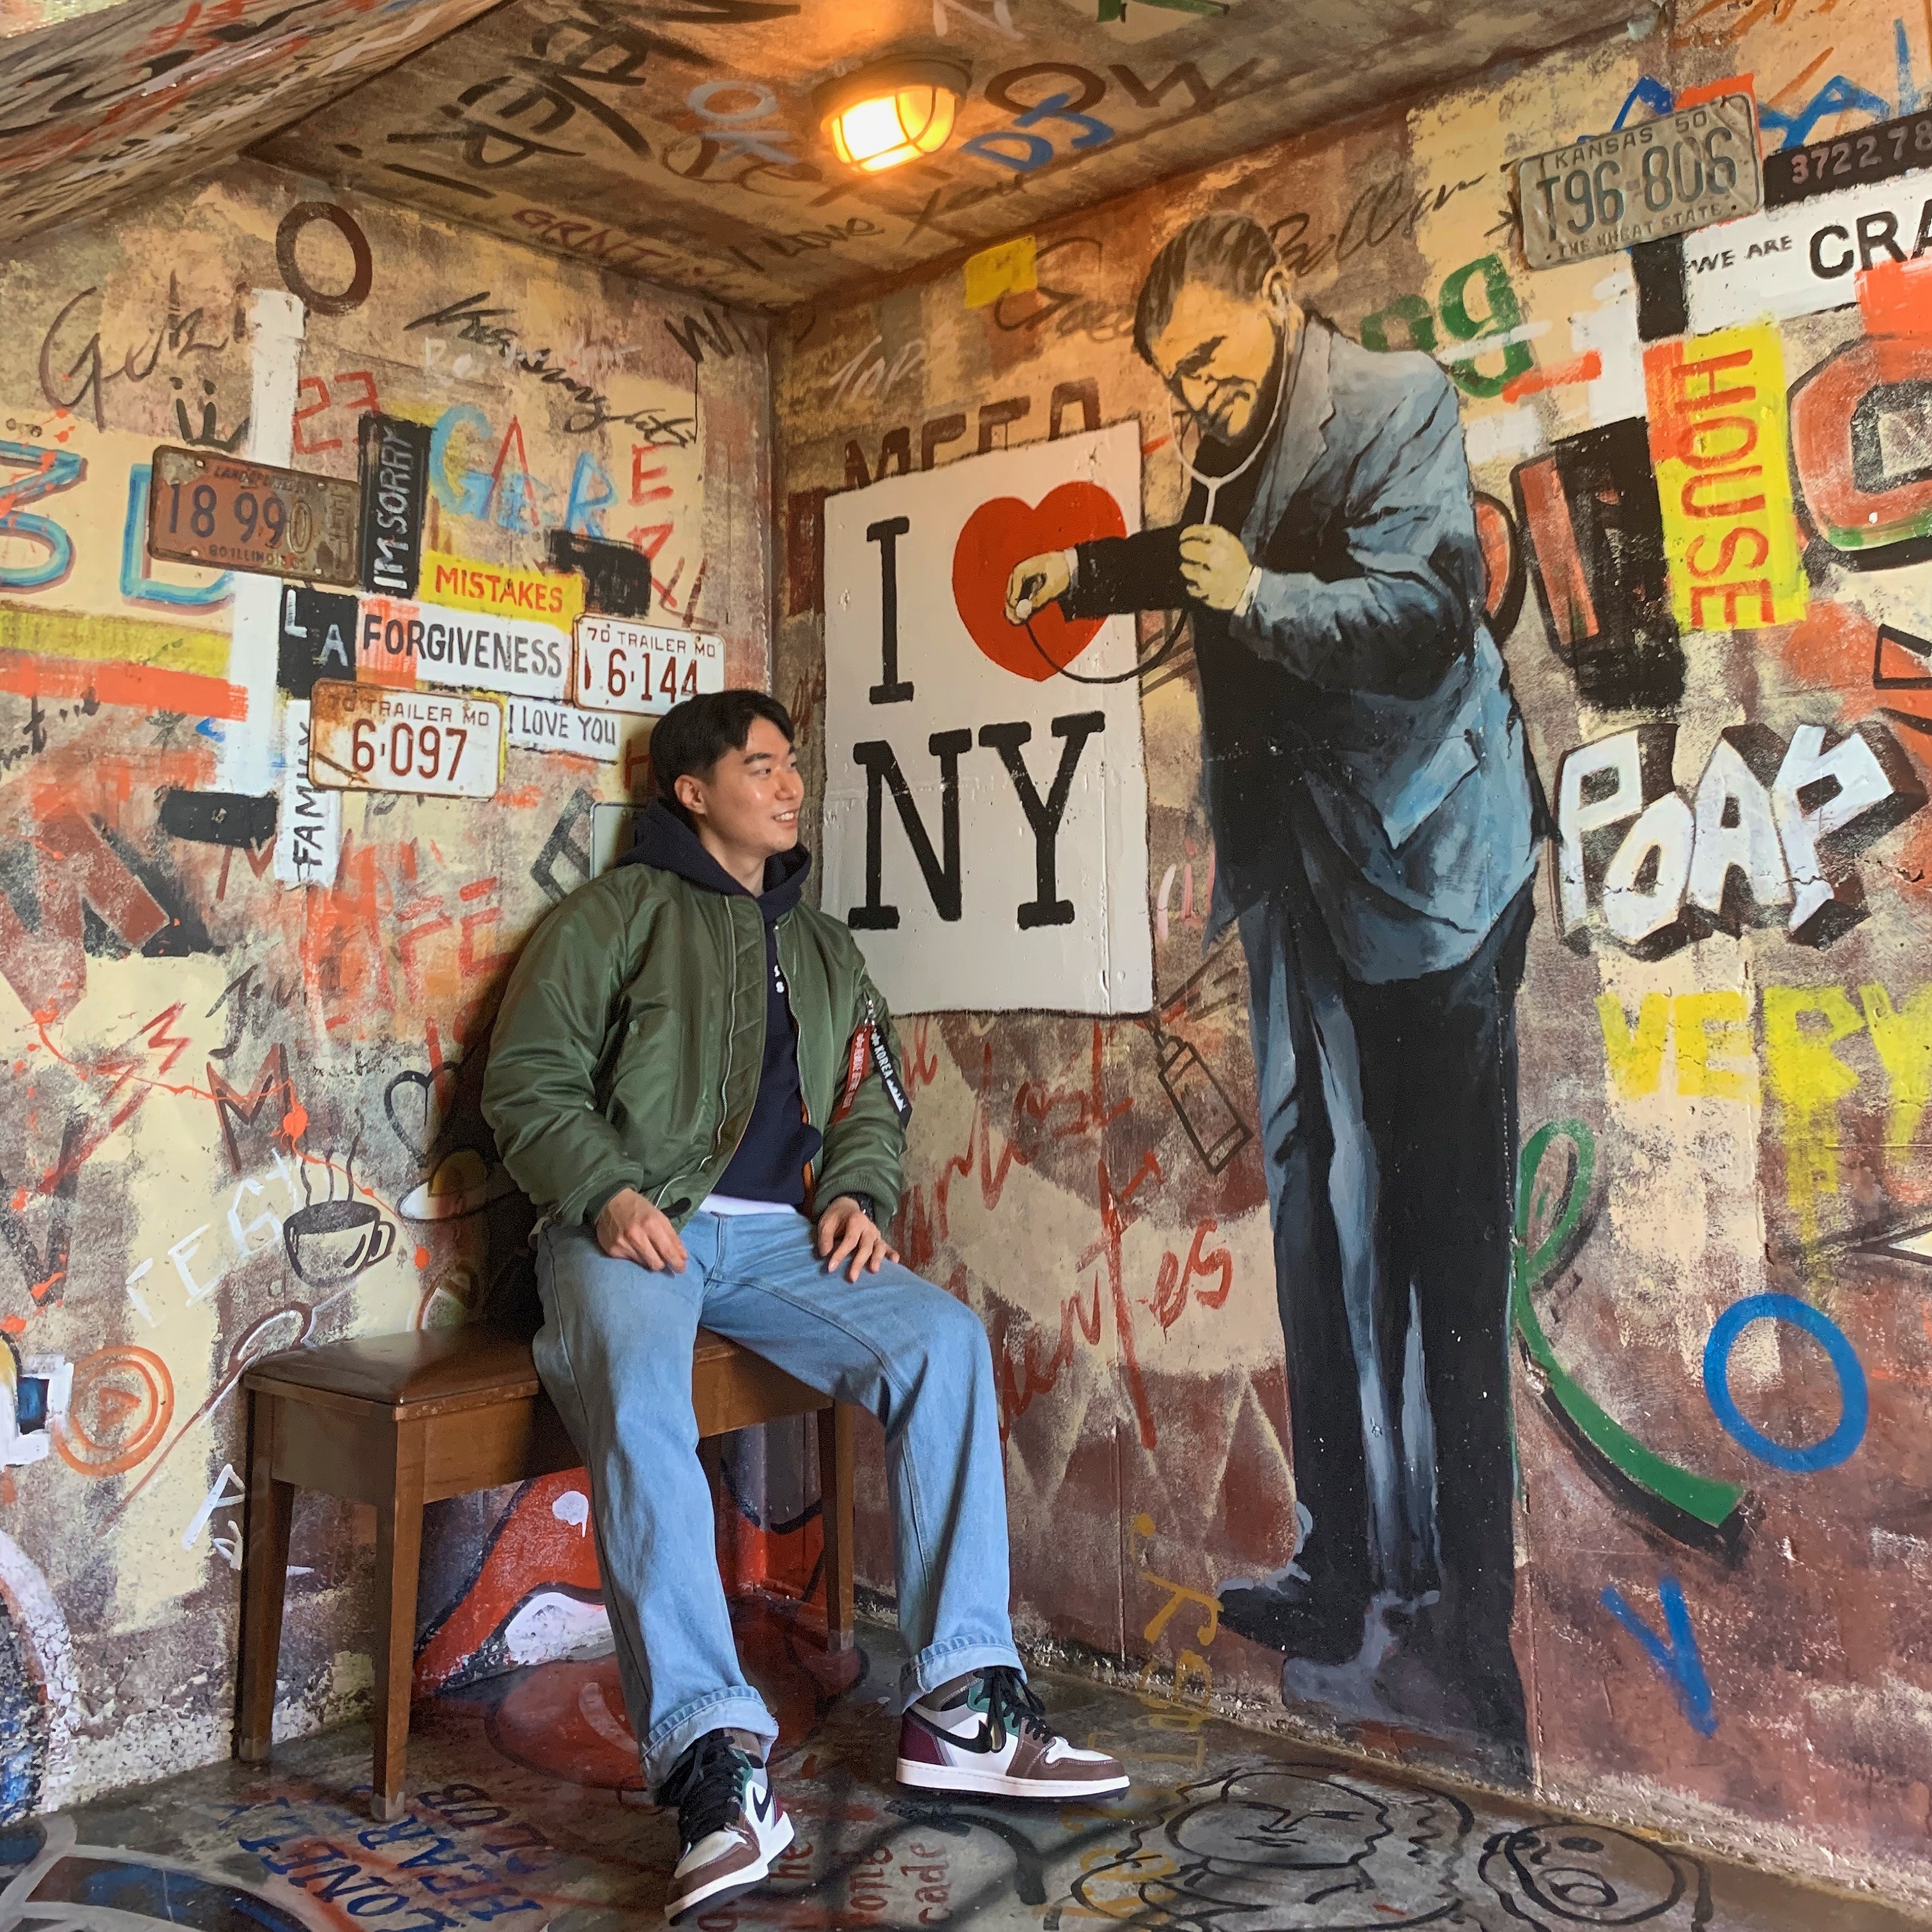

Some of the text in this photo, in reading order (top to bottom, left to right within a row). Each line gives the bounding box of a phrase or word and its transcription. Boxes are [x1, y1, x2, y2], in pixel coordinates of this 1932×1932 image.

[1555, 111, 1708, 169] KANSAS 50
[1661, 204, 1724, 229] STATE
[1683, 250, 1736, 275] WE
[1745, 235, 1793, 260] ARE
[376, 425, 413, 535] SORRY
[1671, 349, 1775, 628] HOUSE
[435, 564, 564, 613] MISTAKES
[866, 515, 915, 705] I
[363, 614, 562, 678] FORGIVENESS
[586, 627, 716, 658] 70 TRAILER MO
[364, 701, 452, 723] TRAILER
[463, 711, 489, 726] MO
[522, 705, 570, 739] LOVE
[577, 714, 616, 746] YOU
[847, 710, 1107, 931] NY
[874, 1045, 894, 1079] KOREA
